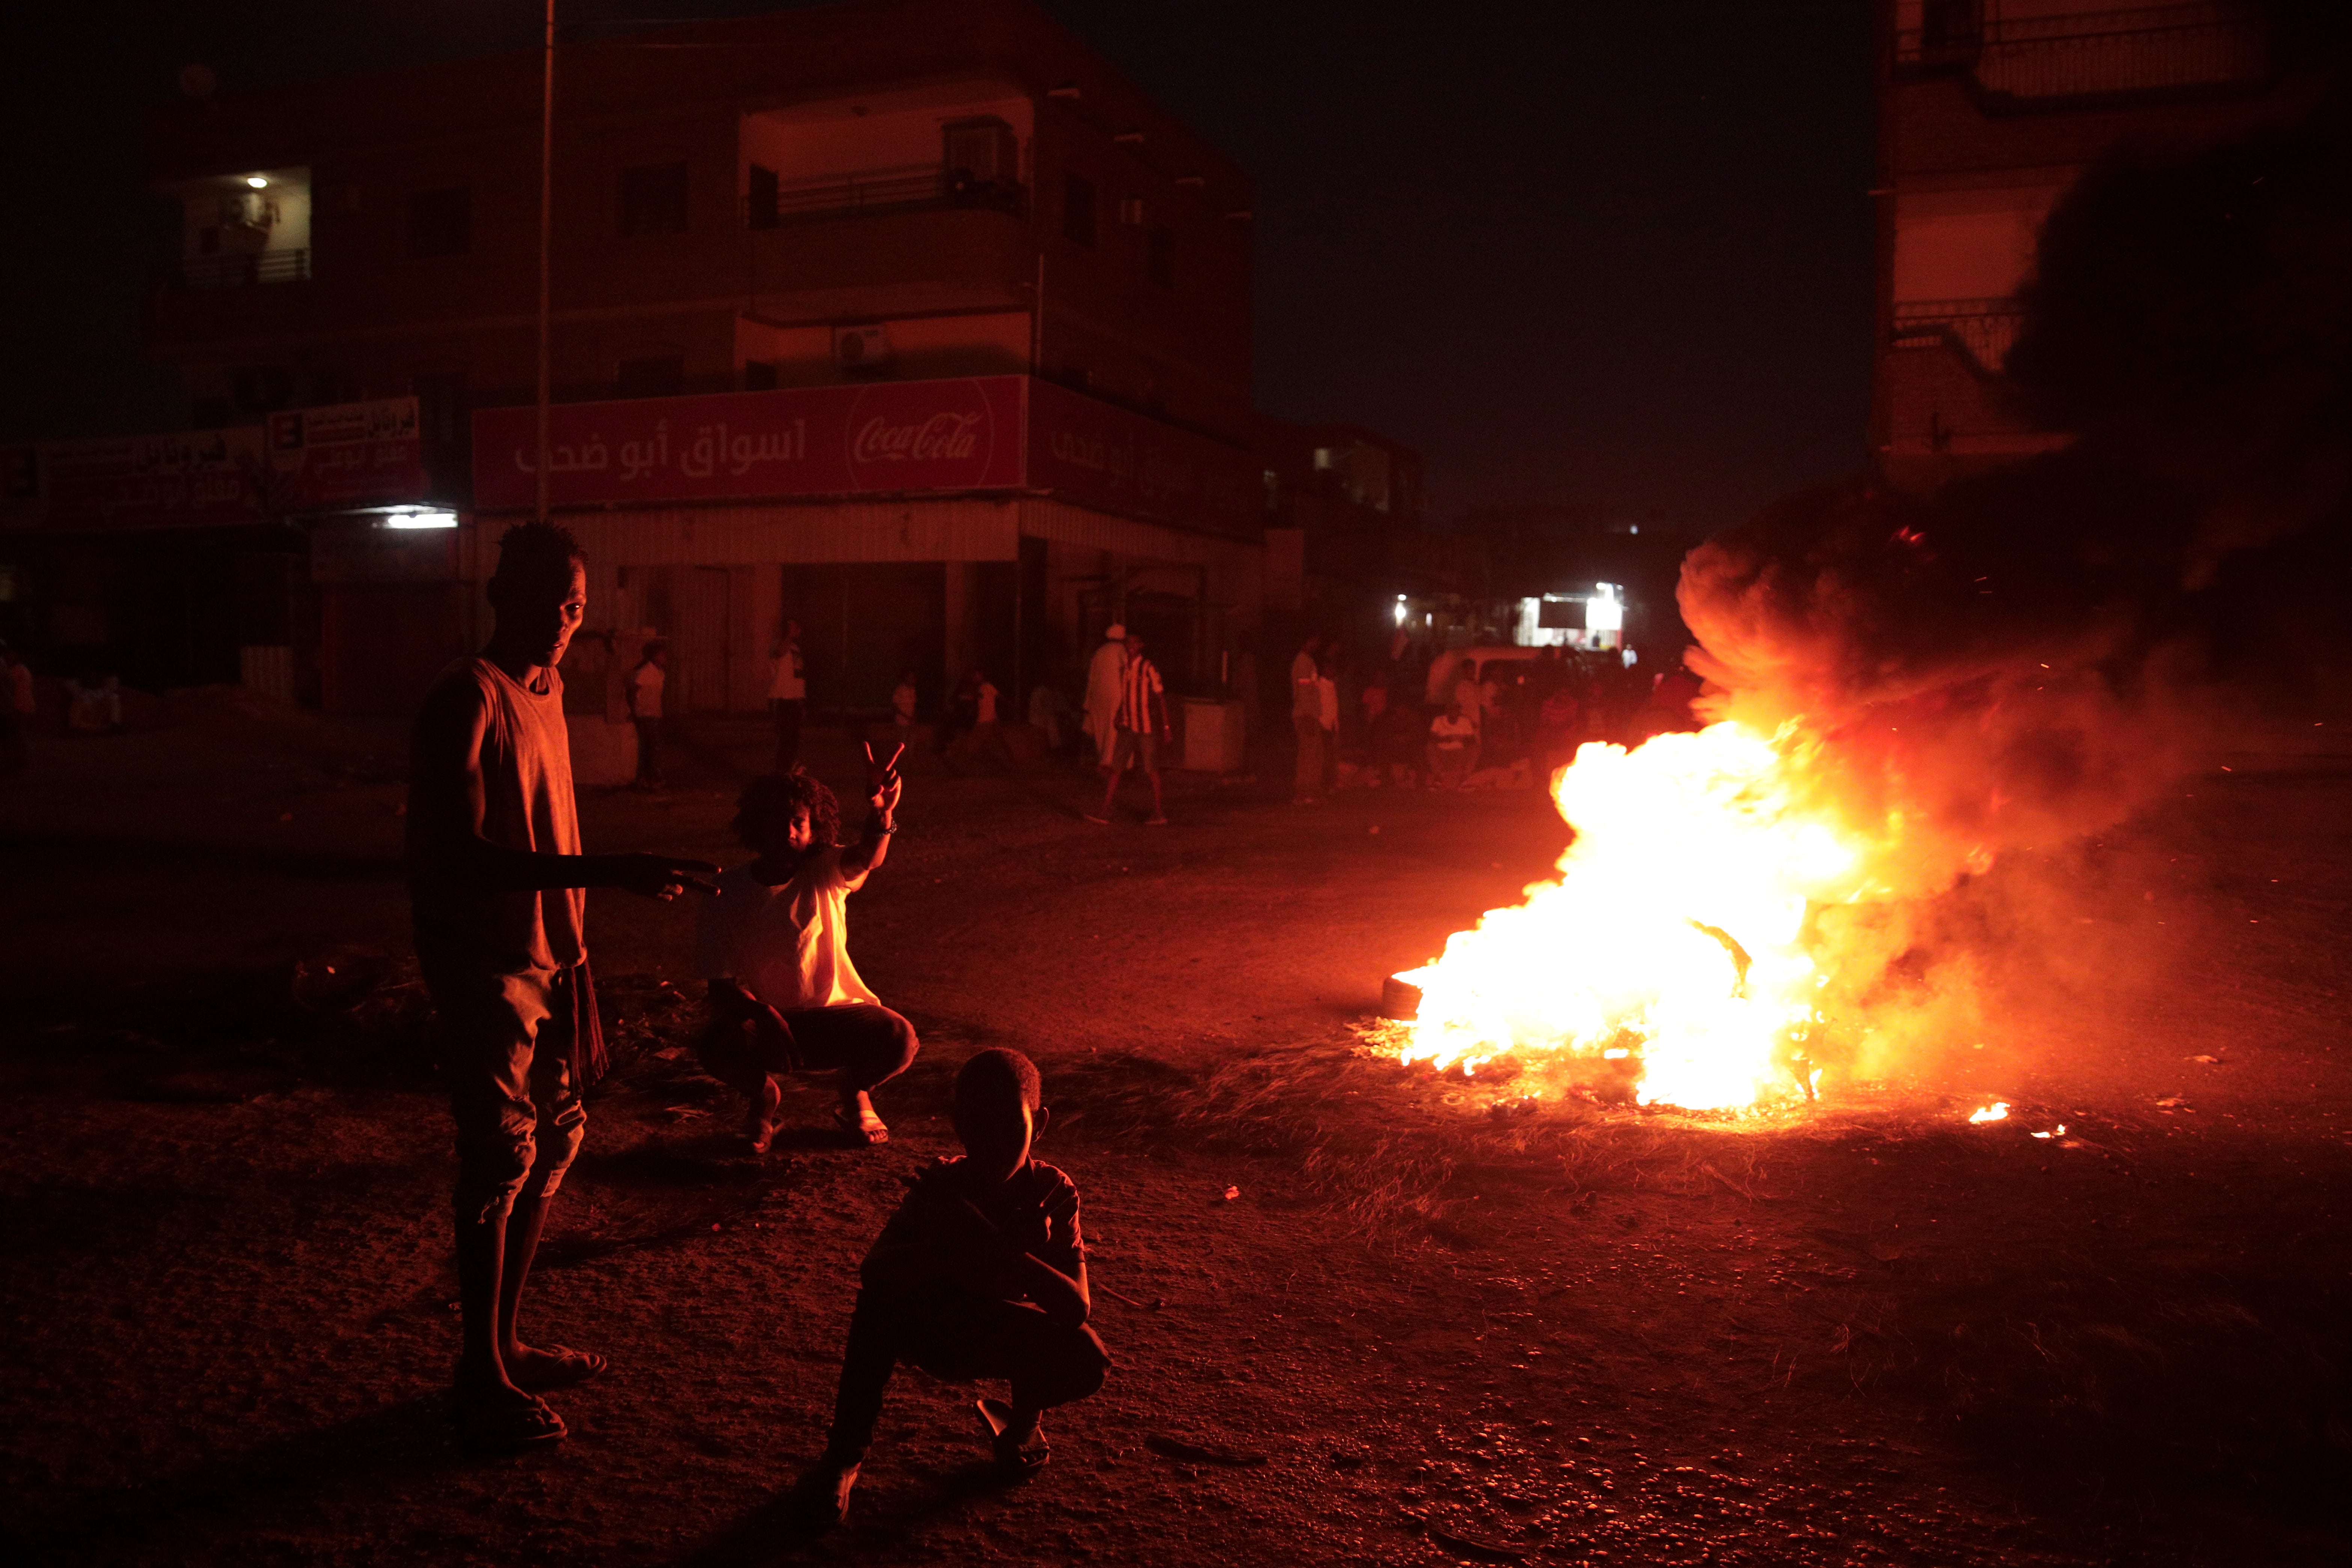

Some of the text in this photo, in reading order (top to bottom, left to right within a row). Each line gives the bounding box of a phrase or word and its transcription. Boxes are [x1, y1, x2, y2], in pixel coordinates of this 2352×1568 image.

[620, 417, 667, 481] أبو
[680, 418, 805, 478] اسواق
[854, 411, 985, 463] Coca-Cola
